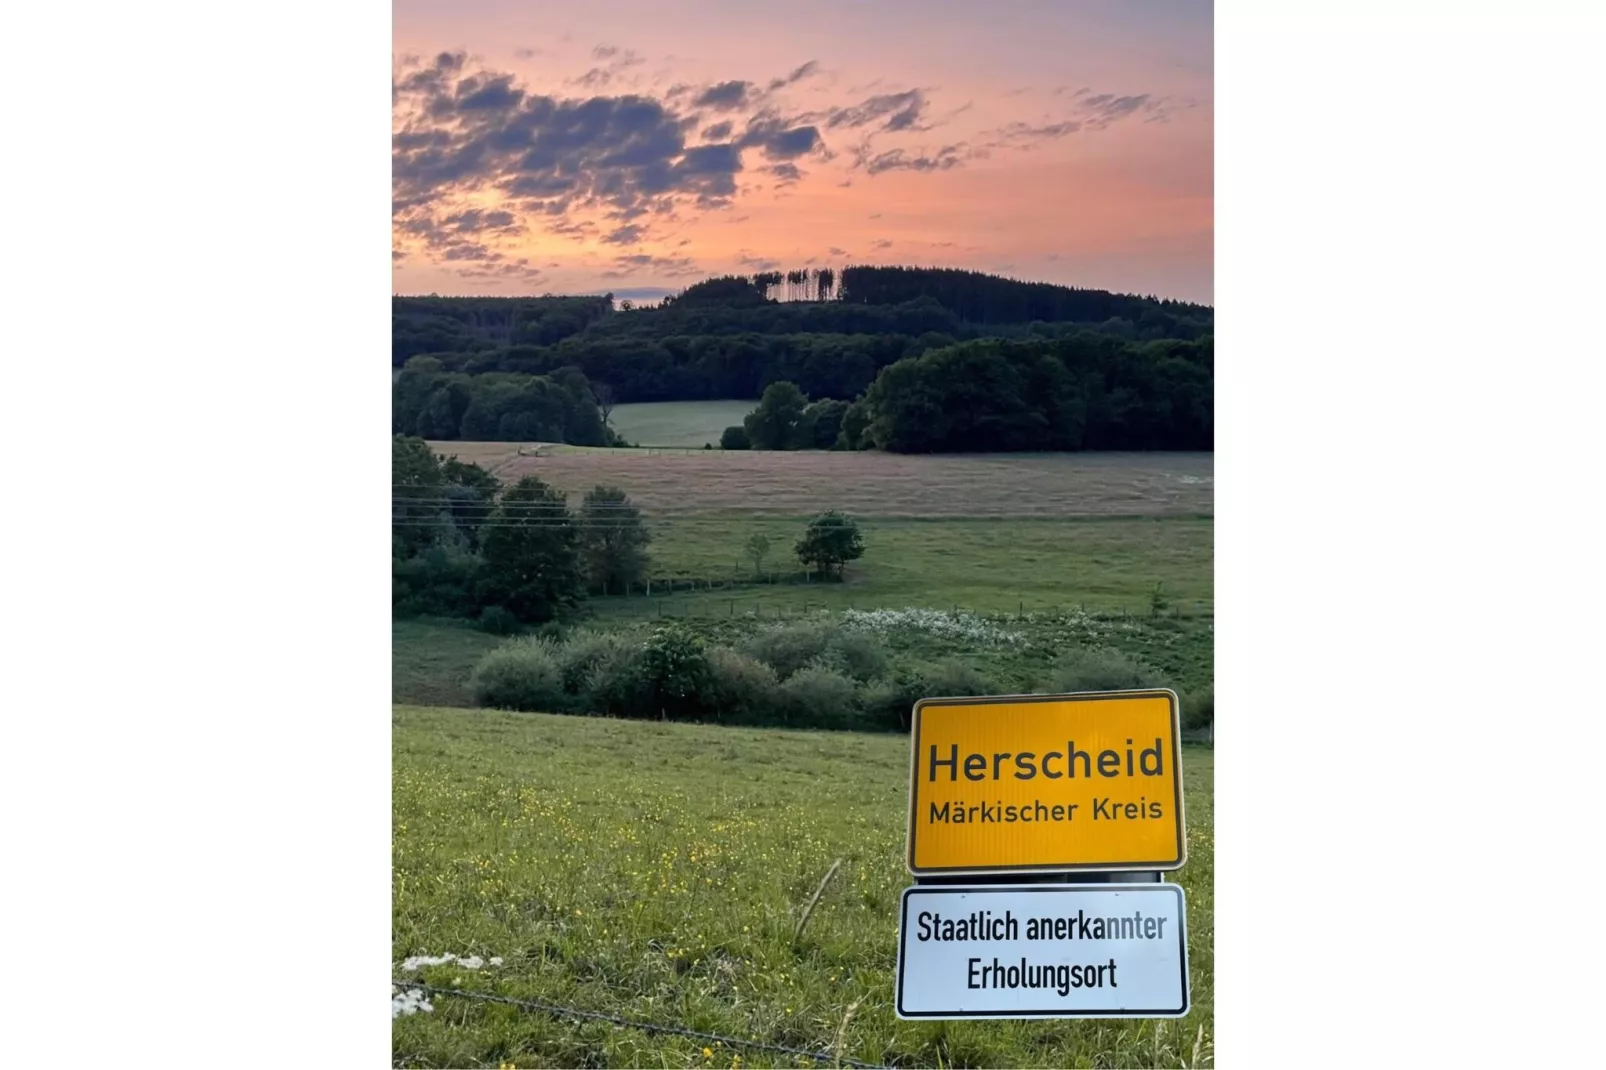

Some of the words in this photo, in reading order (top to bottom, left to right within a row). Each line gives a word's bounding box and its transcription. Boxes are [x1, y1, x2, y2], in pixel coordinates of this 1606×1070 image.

[928, 737, 1164, 783] Herscheid
[929, 800, 1079, 825] Märkischer
[1093, 796, 1163, 821] Kreis
[917, 910, 1018, 942] Staatlich
[1026, 909, 1168, 941] anerkannter
[967, 957, 1118, 997] Erholungsort
